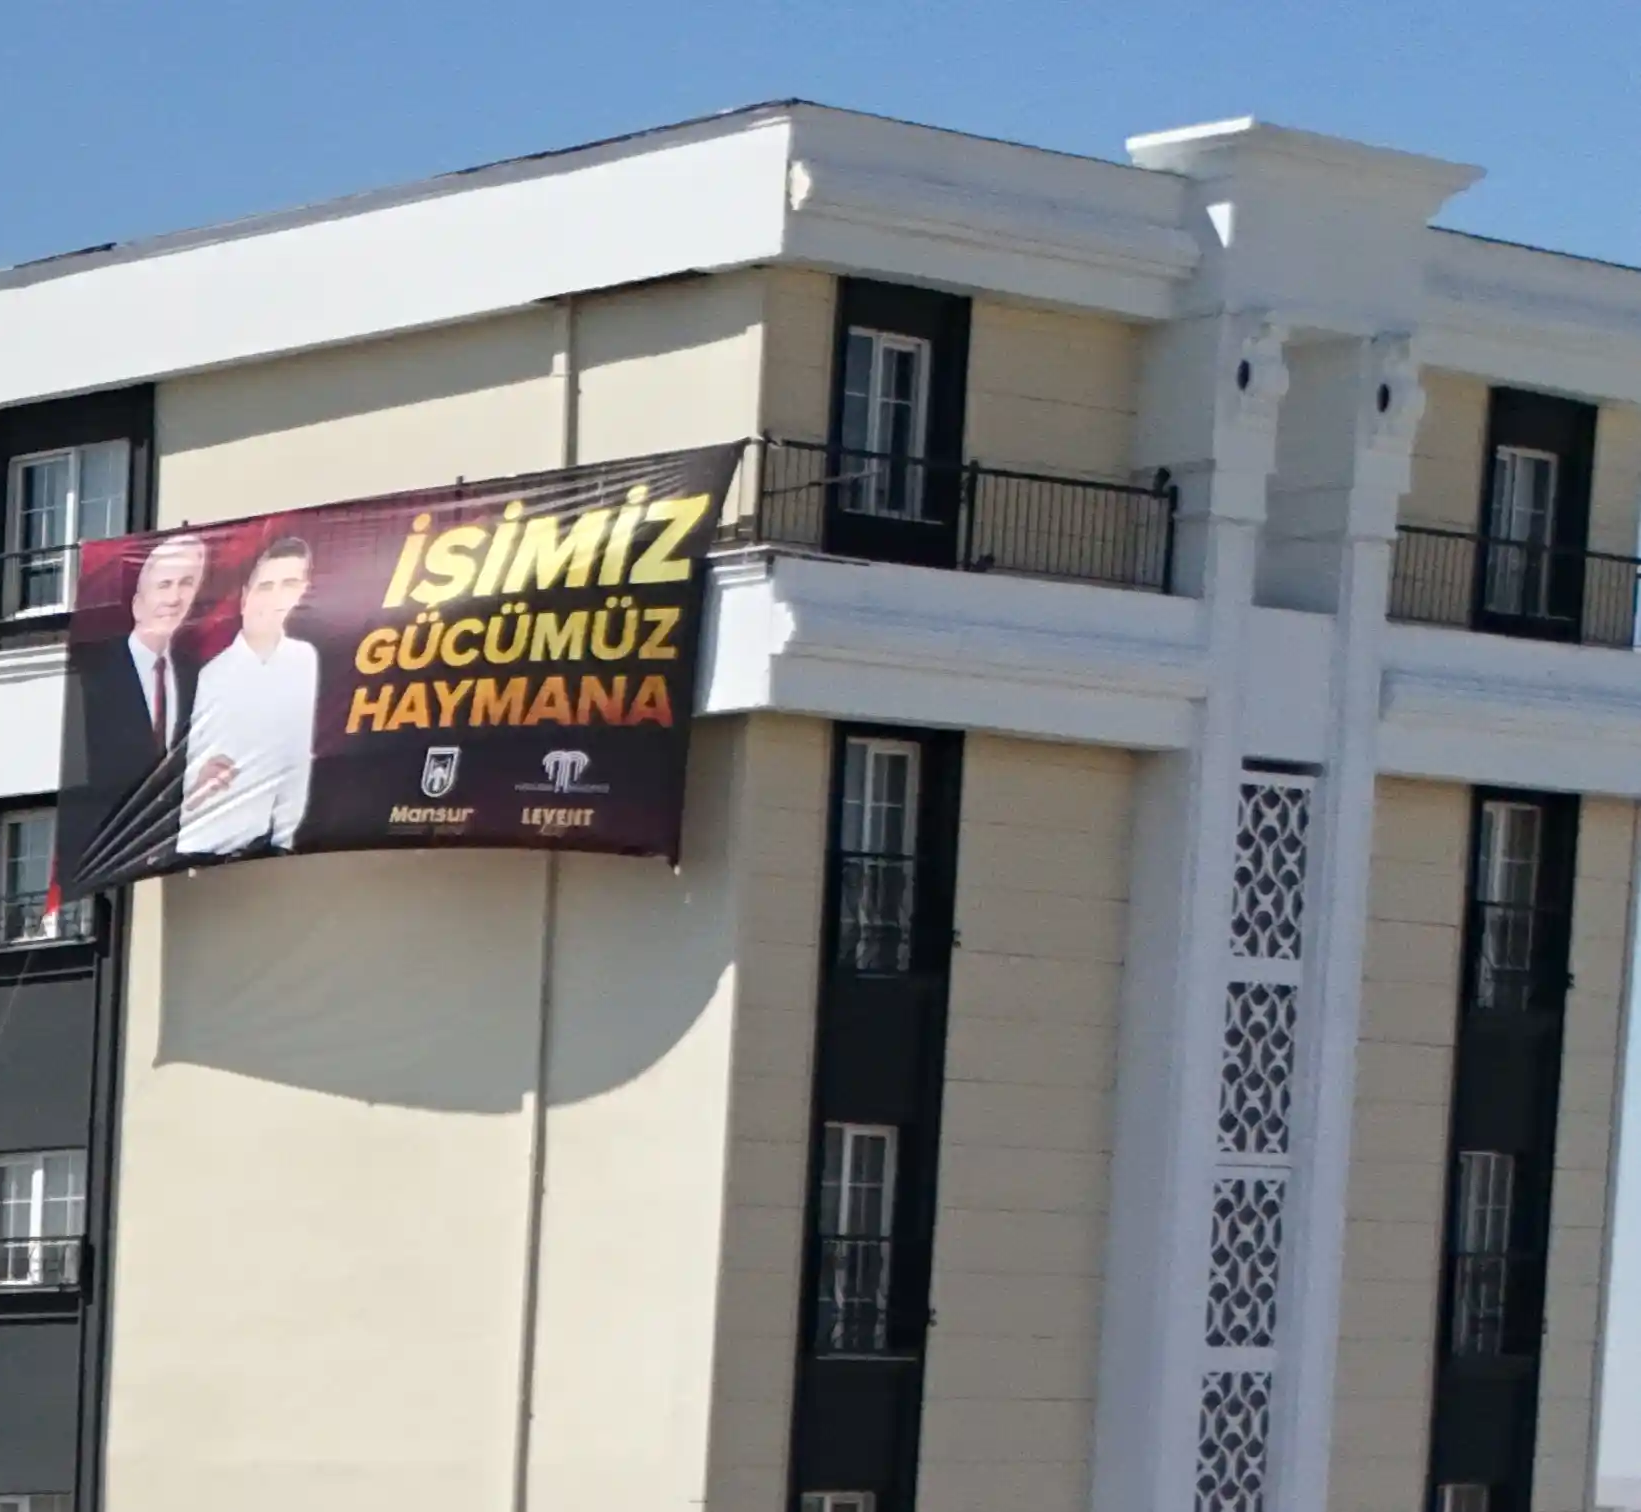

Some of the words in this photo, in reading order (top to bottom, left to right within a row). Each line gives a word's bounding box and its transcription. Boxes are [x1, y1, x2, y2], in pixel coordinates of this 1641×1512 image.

[381, 484, 711, 610] İŞİMİZ
[354, 595, 681, 675] GÜCÜMÜZ
[344, 674, 674, 735] HAYMANA
[388, 805, 474, 825] Mansur
[520, 807, 595, 827] LEVENT
